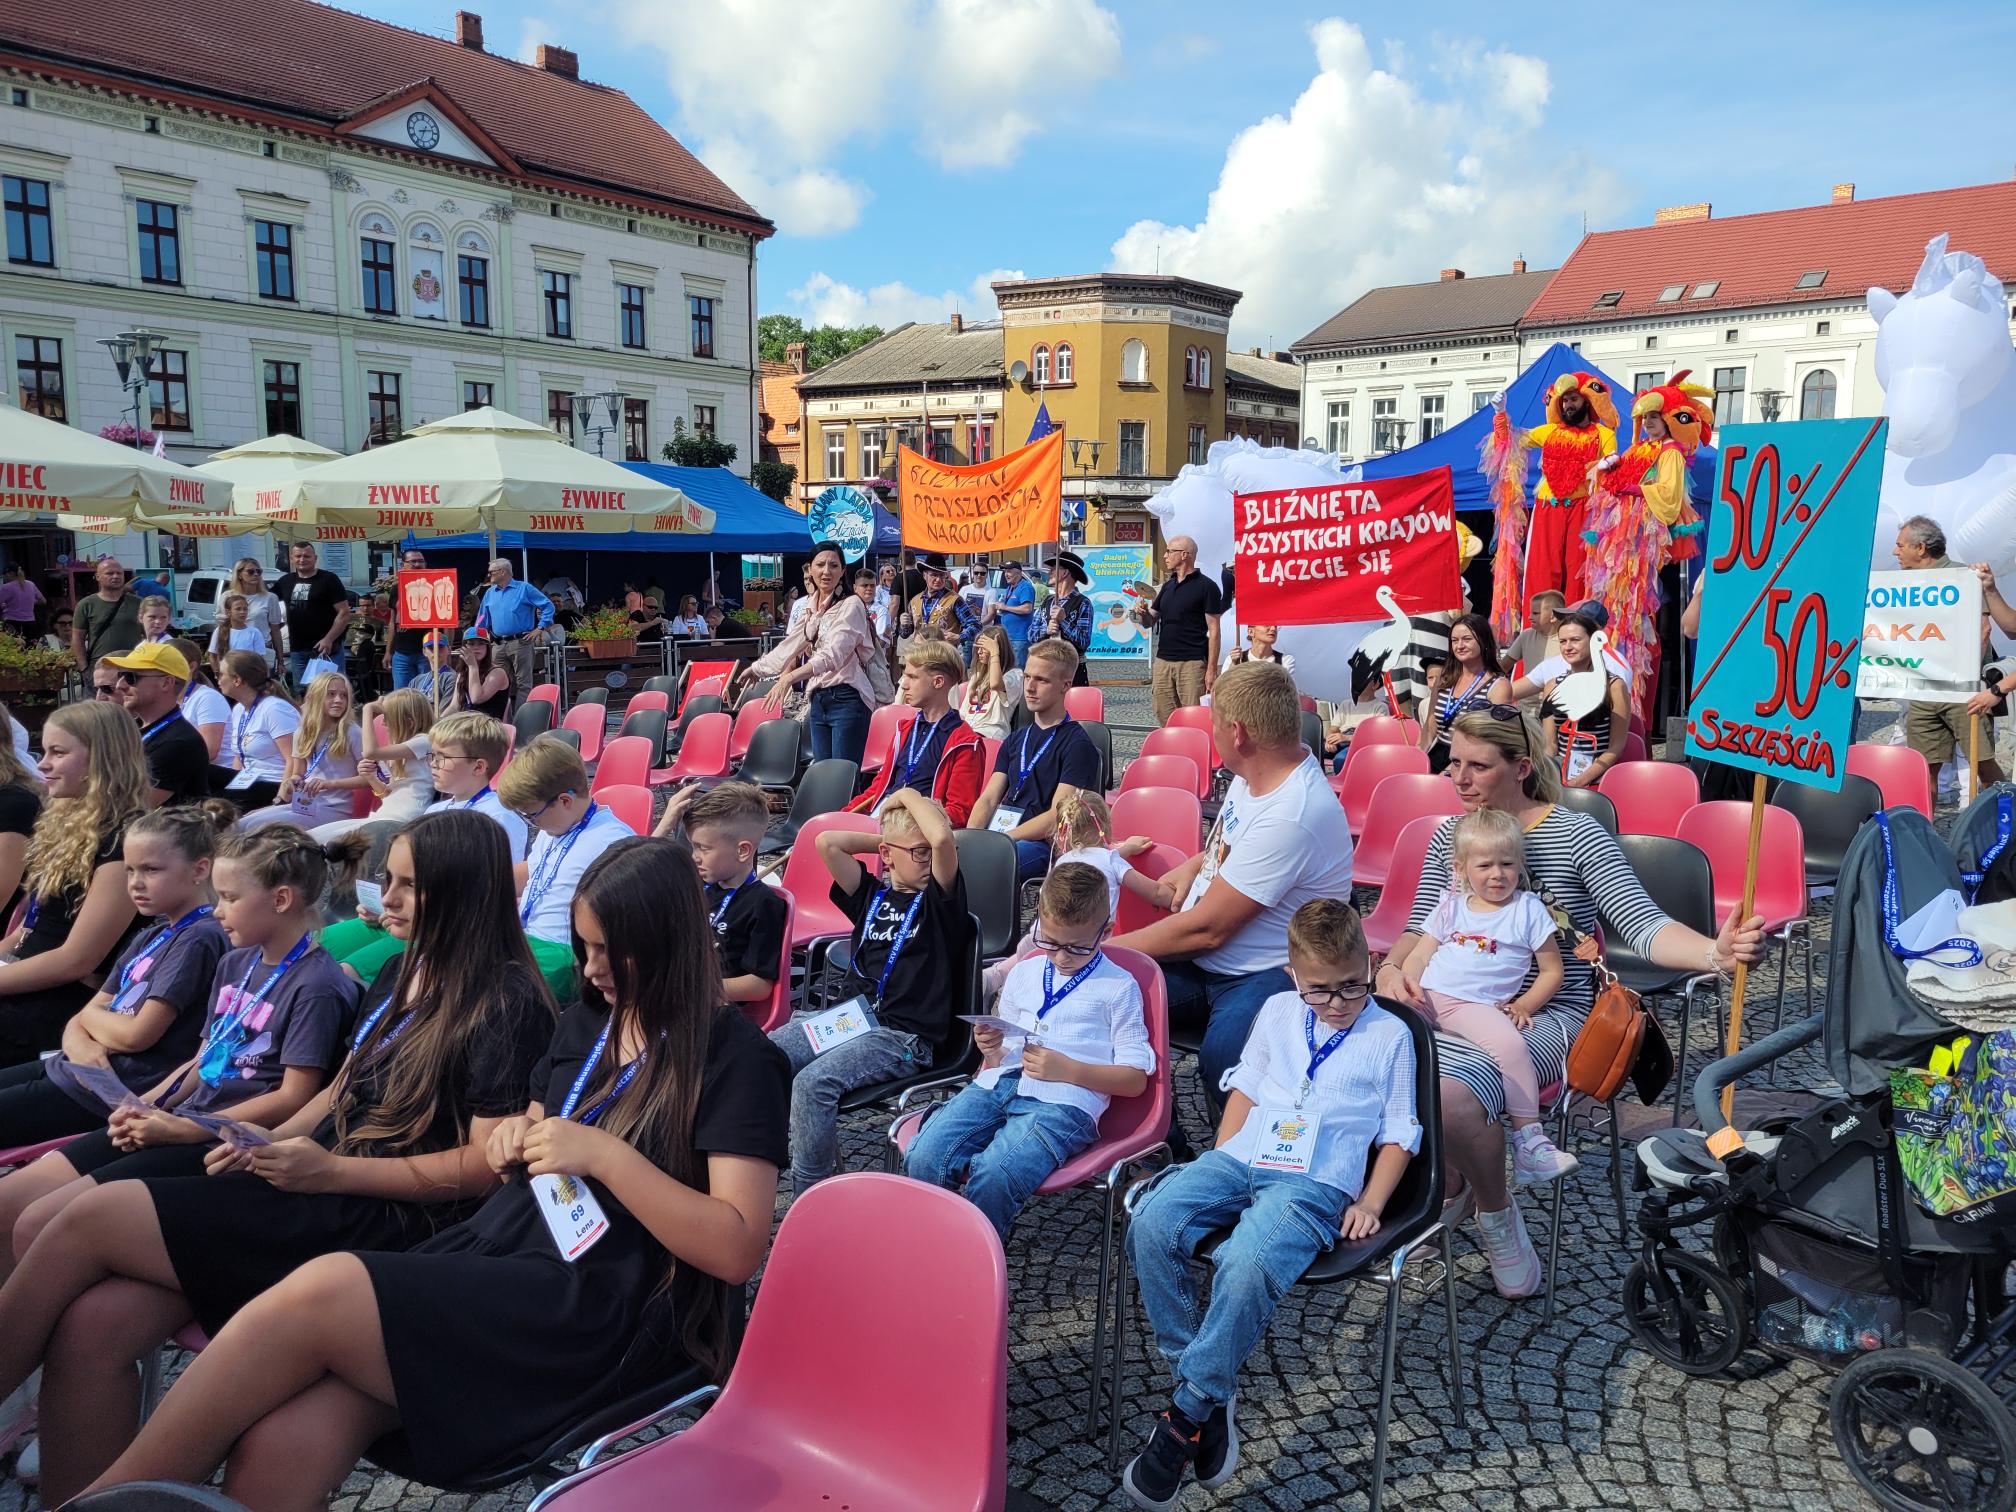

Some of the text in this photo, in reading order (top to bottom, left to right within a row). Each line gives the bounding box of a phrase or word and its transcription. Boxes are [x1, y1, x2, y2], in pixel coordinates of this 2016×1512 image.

[170, 475, 205, 504] ŻYWIEC
[256, 490, 282, 510] ŻYWIEC
[368, 484, 441, 504] ŻYWIEC
[562, 487, 626, 511] ŻYWIEC
[1712, 444, 1822, 573] 50%
[1360, 505, 1452, 543] KRAJÓW
[1755, 589, 1858, 720] 50%
[1261, 1153, 1303, 1164] Wojciech
[1276, 1143, 1293, 1153] 20
[1877, 1154, 1889, 1230] Roadster Duo SLX
[571, 1204, 585, 1222] 69
[575, 1219, 595, 1238] Lena
